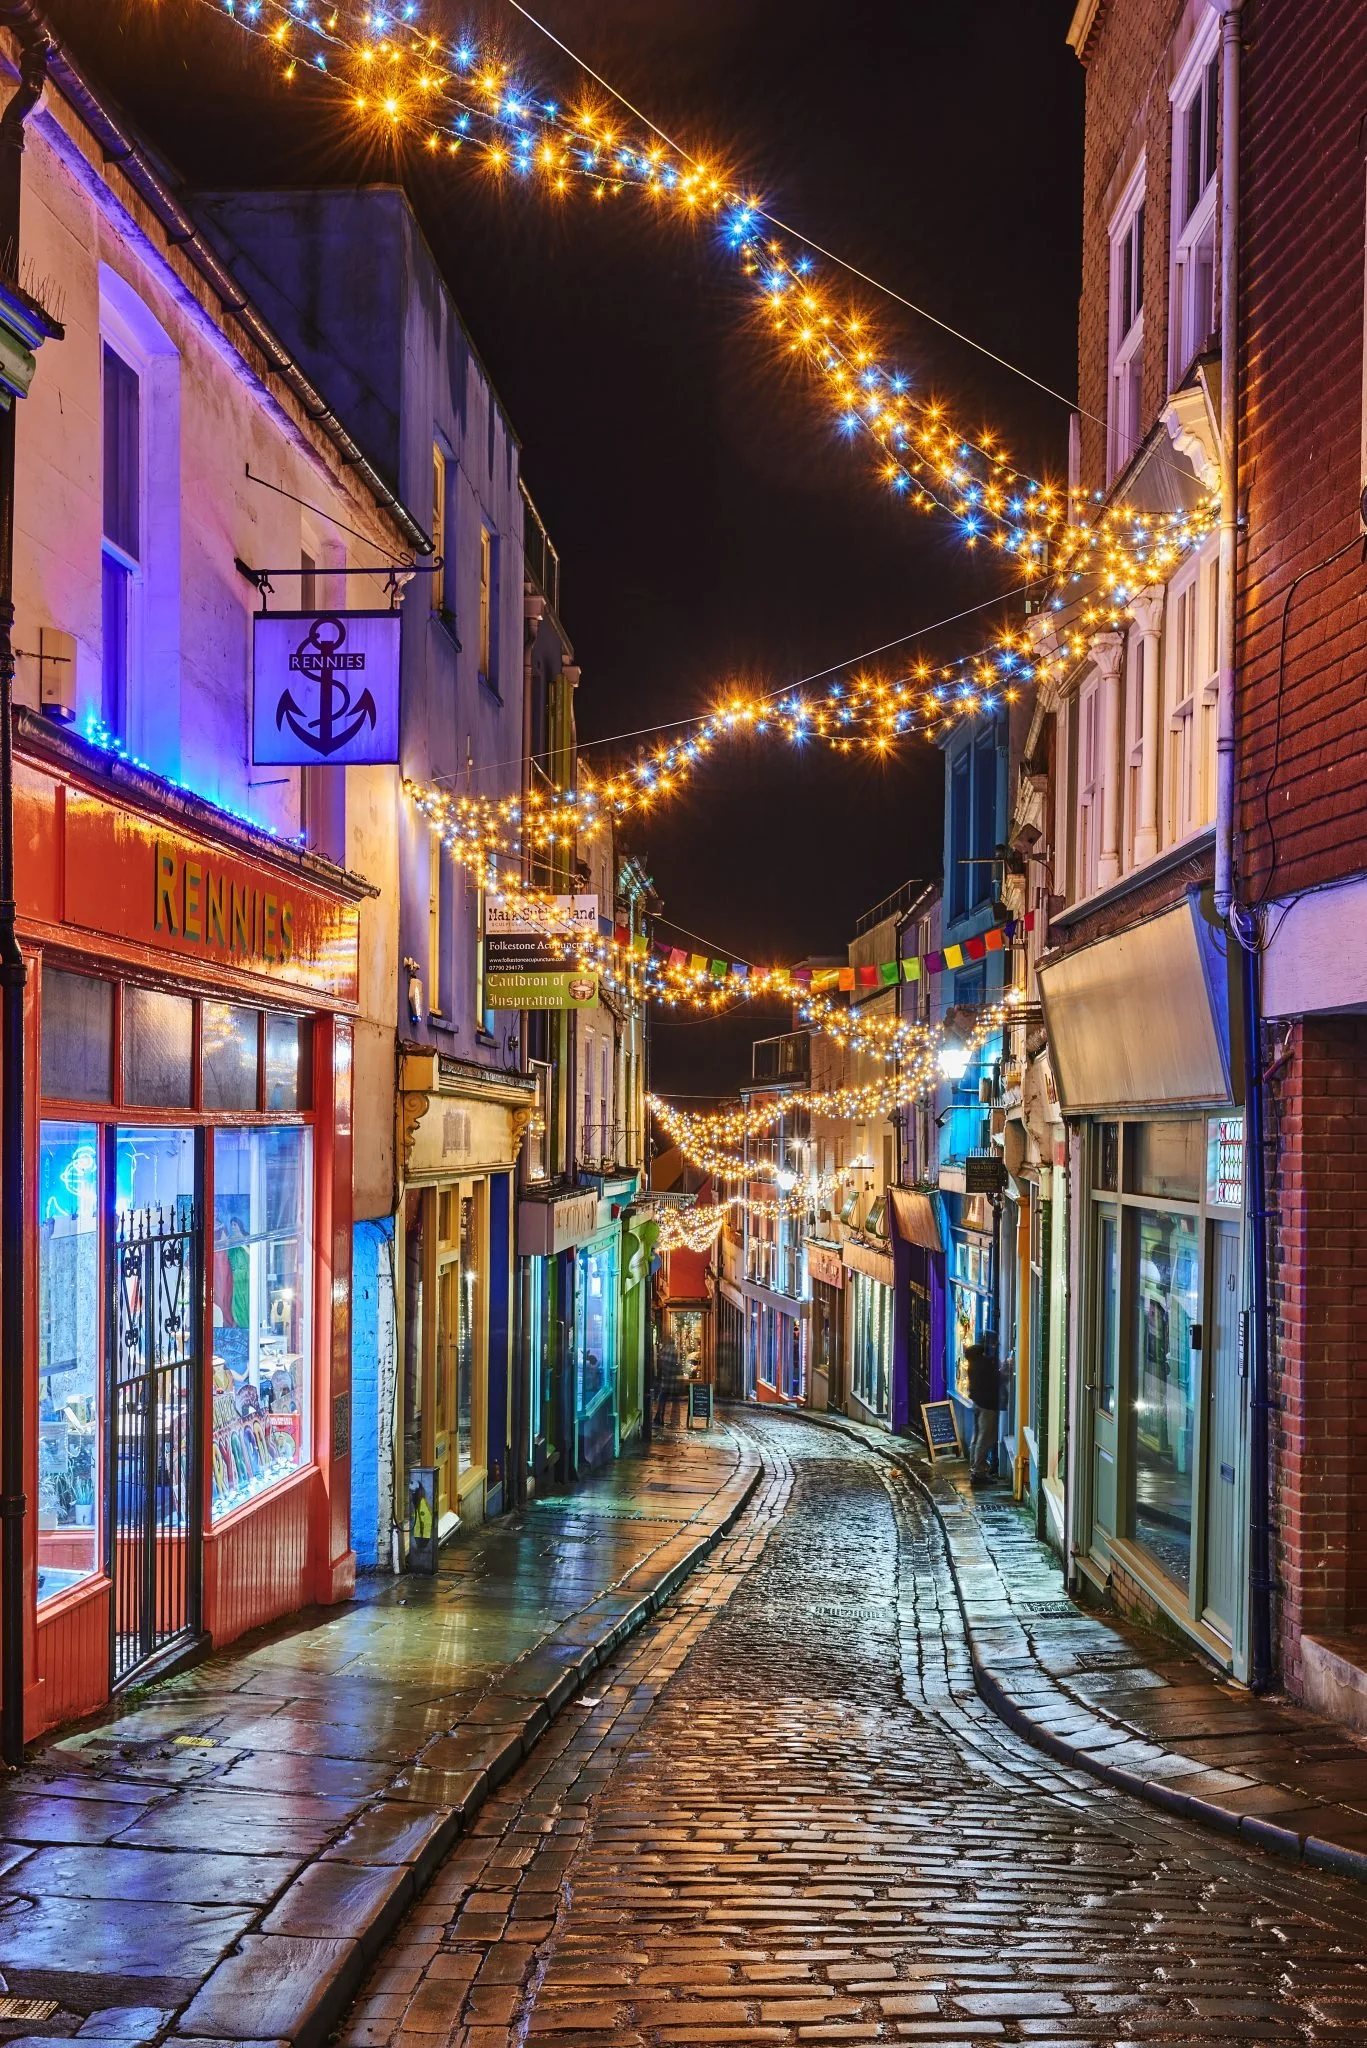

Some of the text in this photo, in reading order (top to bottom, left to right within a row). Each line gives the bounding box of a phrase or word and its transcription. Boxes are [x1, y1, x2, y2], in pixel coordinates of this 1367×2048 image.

[291, 655, 364, 669] RENNIES
[153, 839, 294, 964] RENNIES
[488, 941, 535, 951] Folkestone
[488, 974, 565, 987] Cauldron of
[488, 993, 563, 1008] Inspiration
